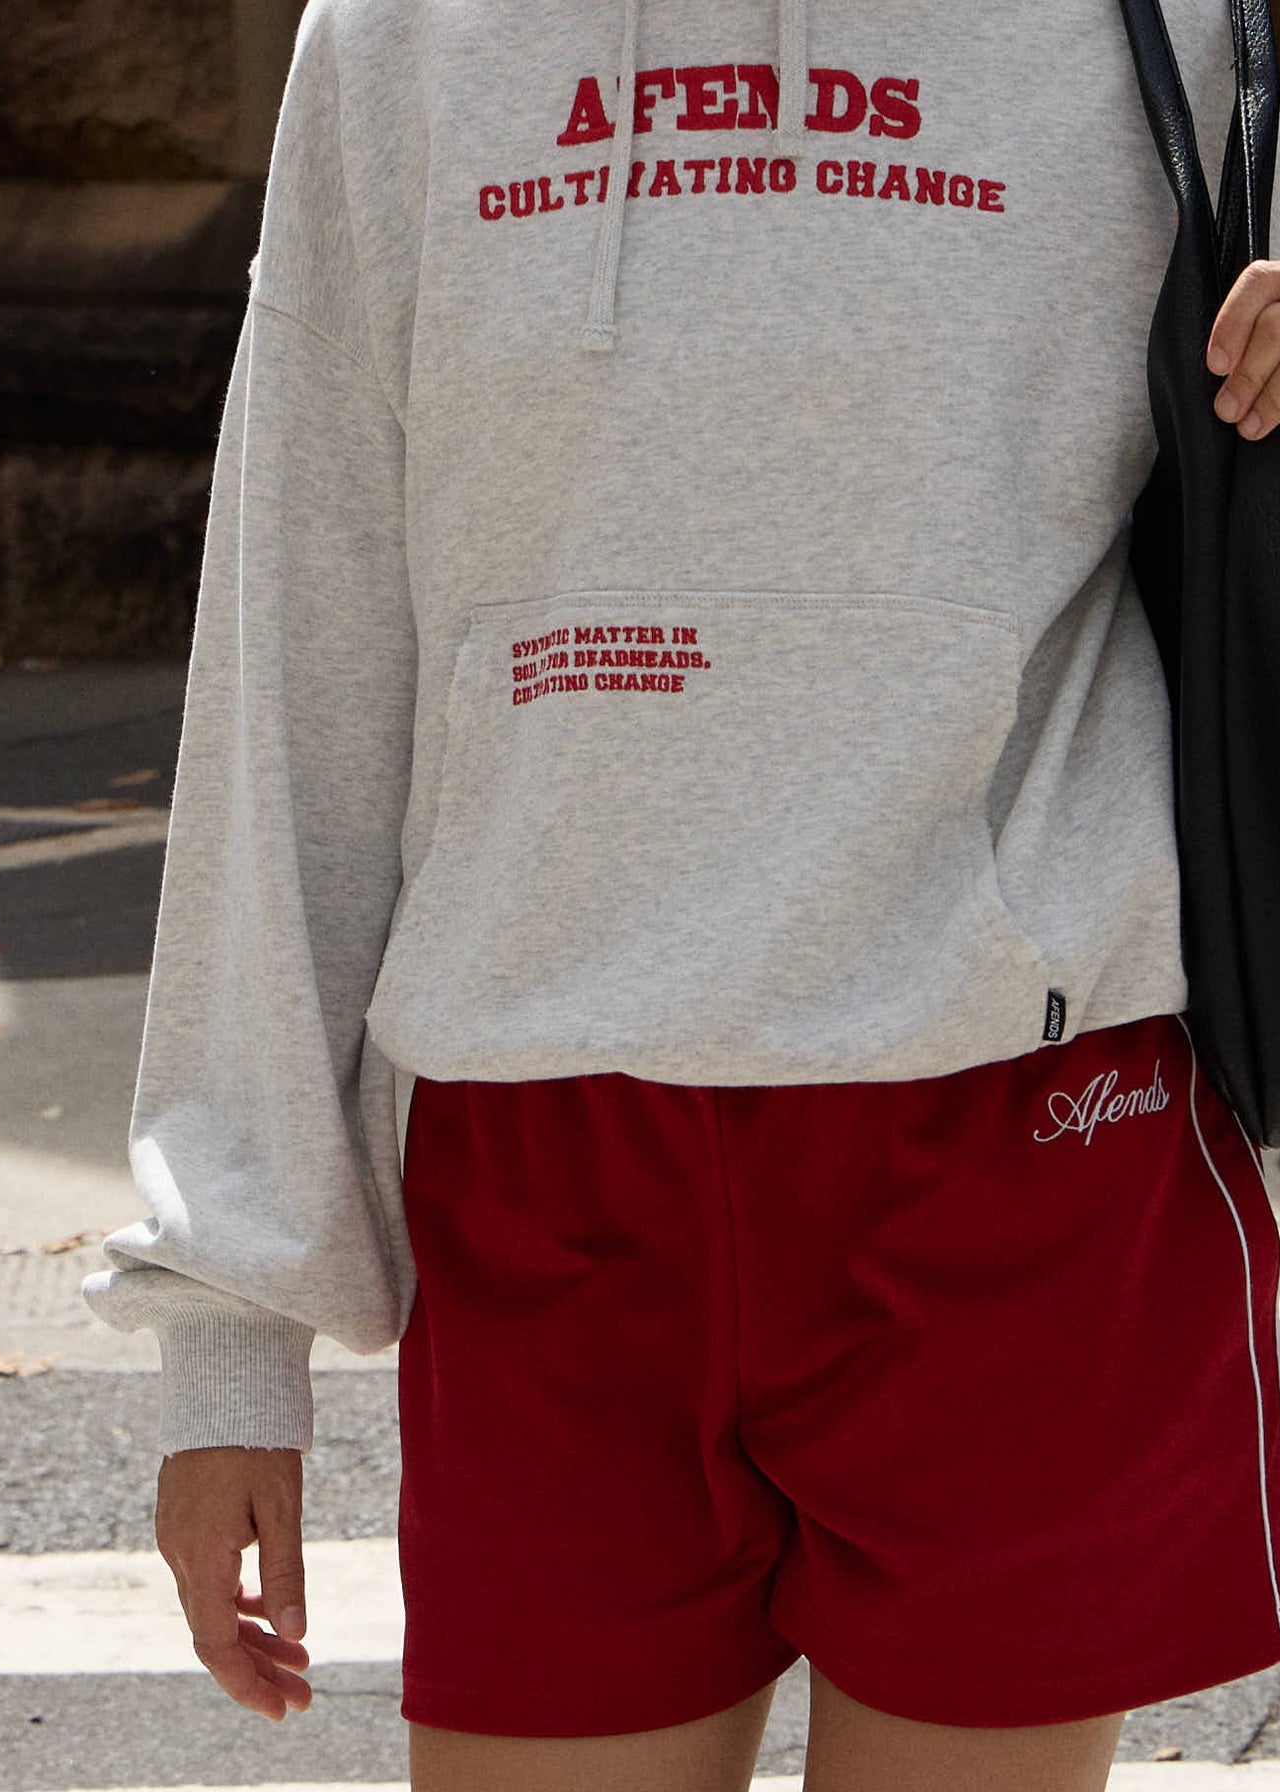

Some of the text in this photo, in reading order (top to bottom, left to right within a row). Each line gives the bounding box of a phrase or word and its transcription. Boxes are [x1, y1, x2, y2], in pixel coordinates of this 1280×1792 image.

[557, 64, 920, 146] AFENDS
[816, 161, 1005, 212] CHANGE
[576, 627, 664, 643] MATTER
[673, 628, 696, 644] IN
[574, 650, 710, 668] DEADHEADS.
[595, 674, 683, 692] CHANGE
[1033, 1058, 1170, 1146] Afends
